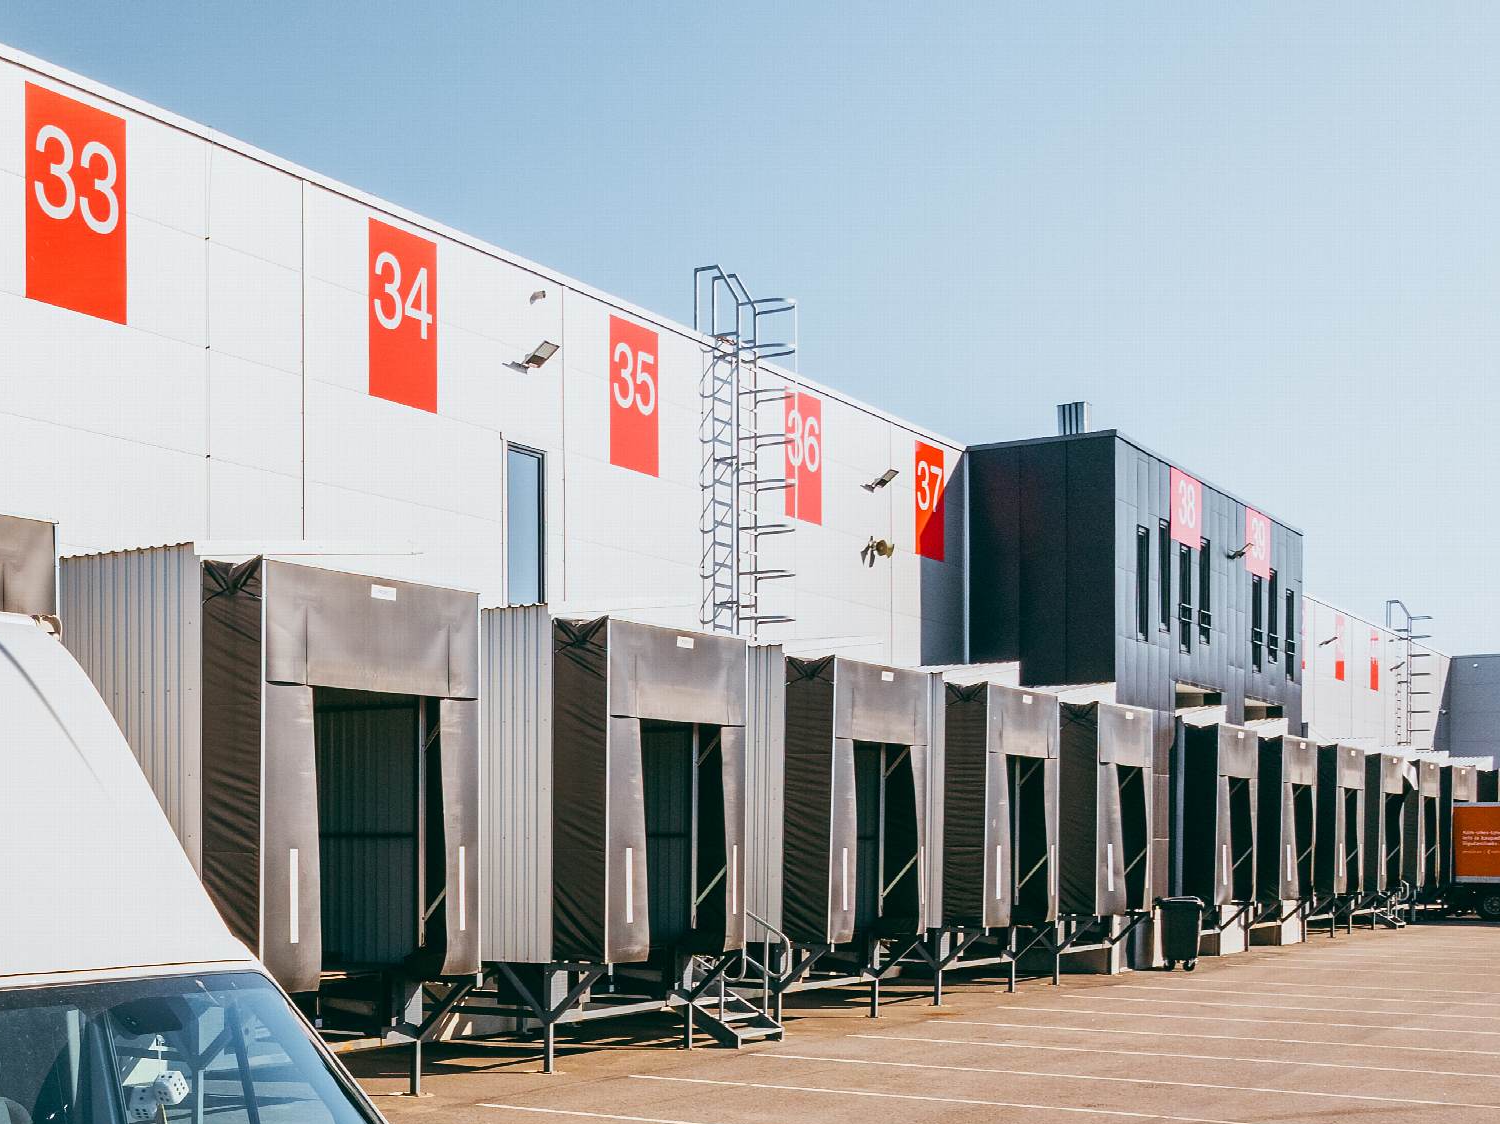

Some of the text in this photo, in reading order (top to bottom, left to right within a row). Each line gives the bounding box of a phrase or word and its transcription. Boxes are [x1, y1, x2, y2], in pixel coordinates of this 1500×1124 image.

[34, 124, 119, 234] 33
[374, 251, 433, 340] 34
[613, 342, 655, 416] 35
[787, 409, 820, 473] 36
[917, 460, 943, 513] 37
[1178, 479, 1196, 529] 38
